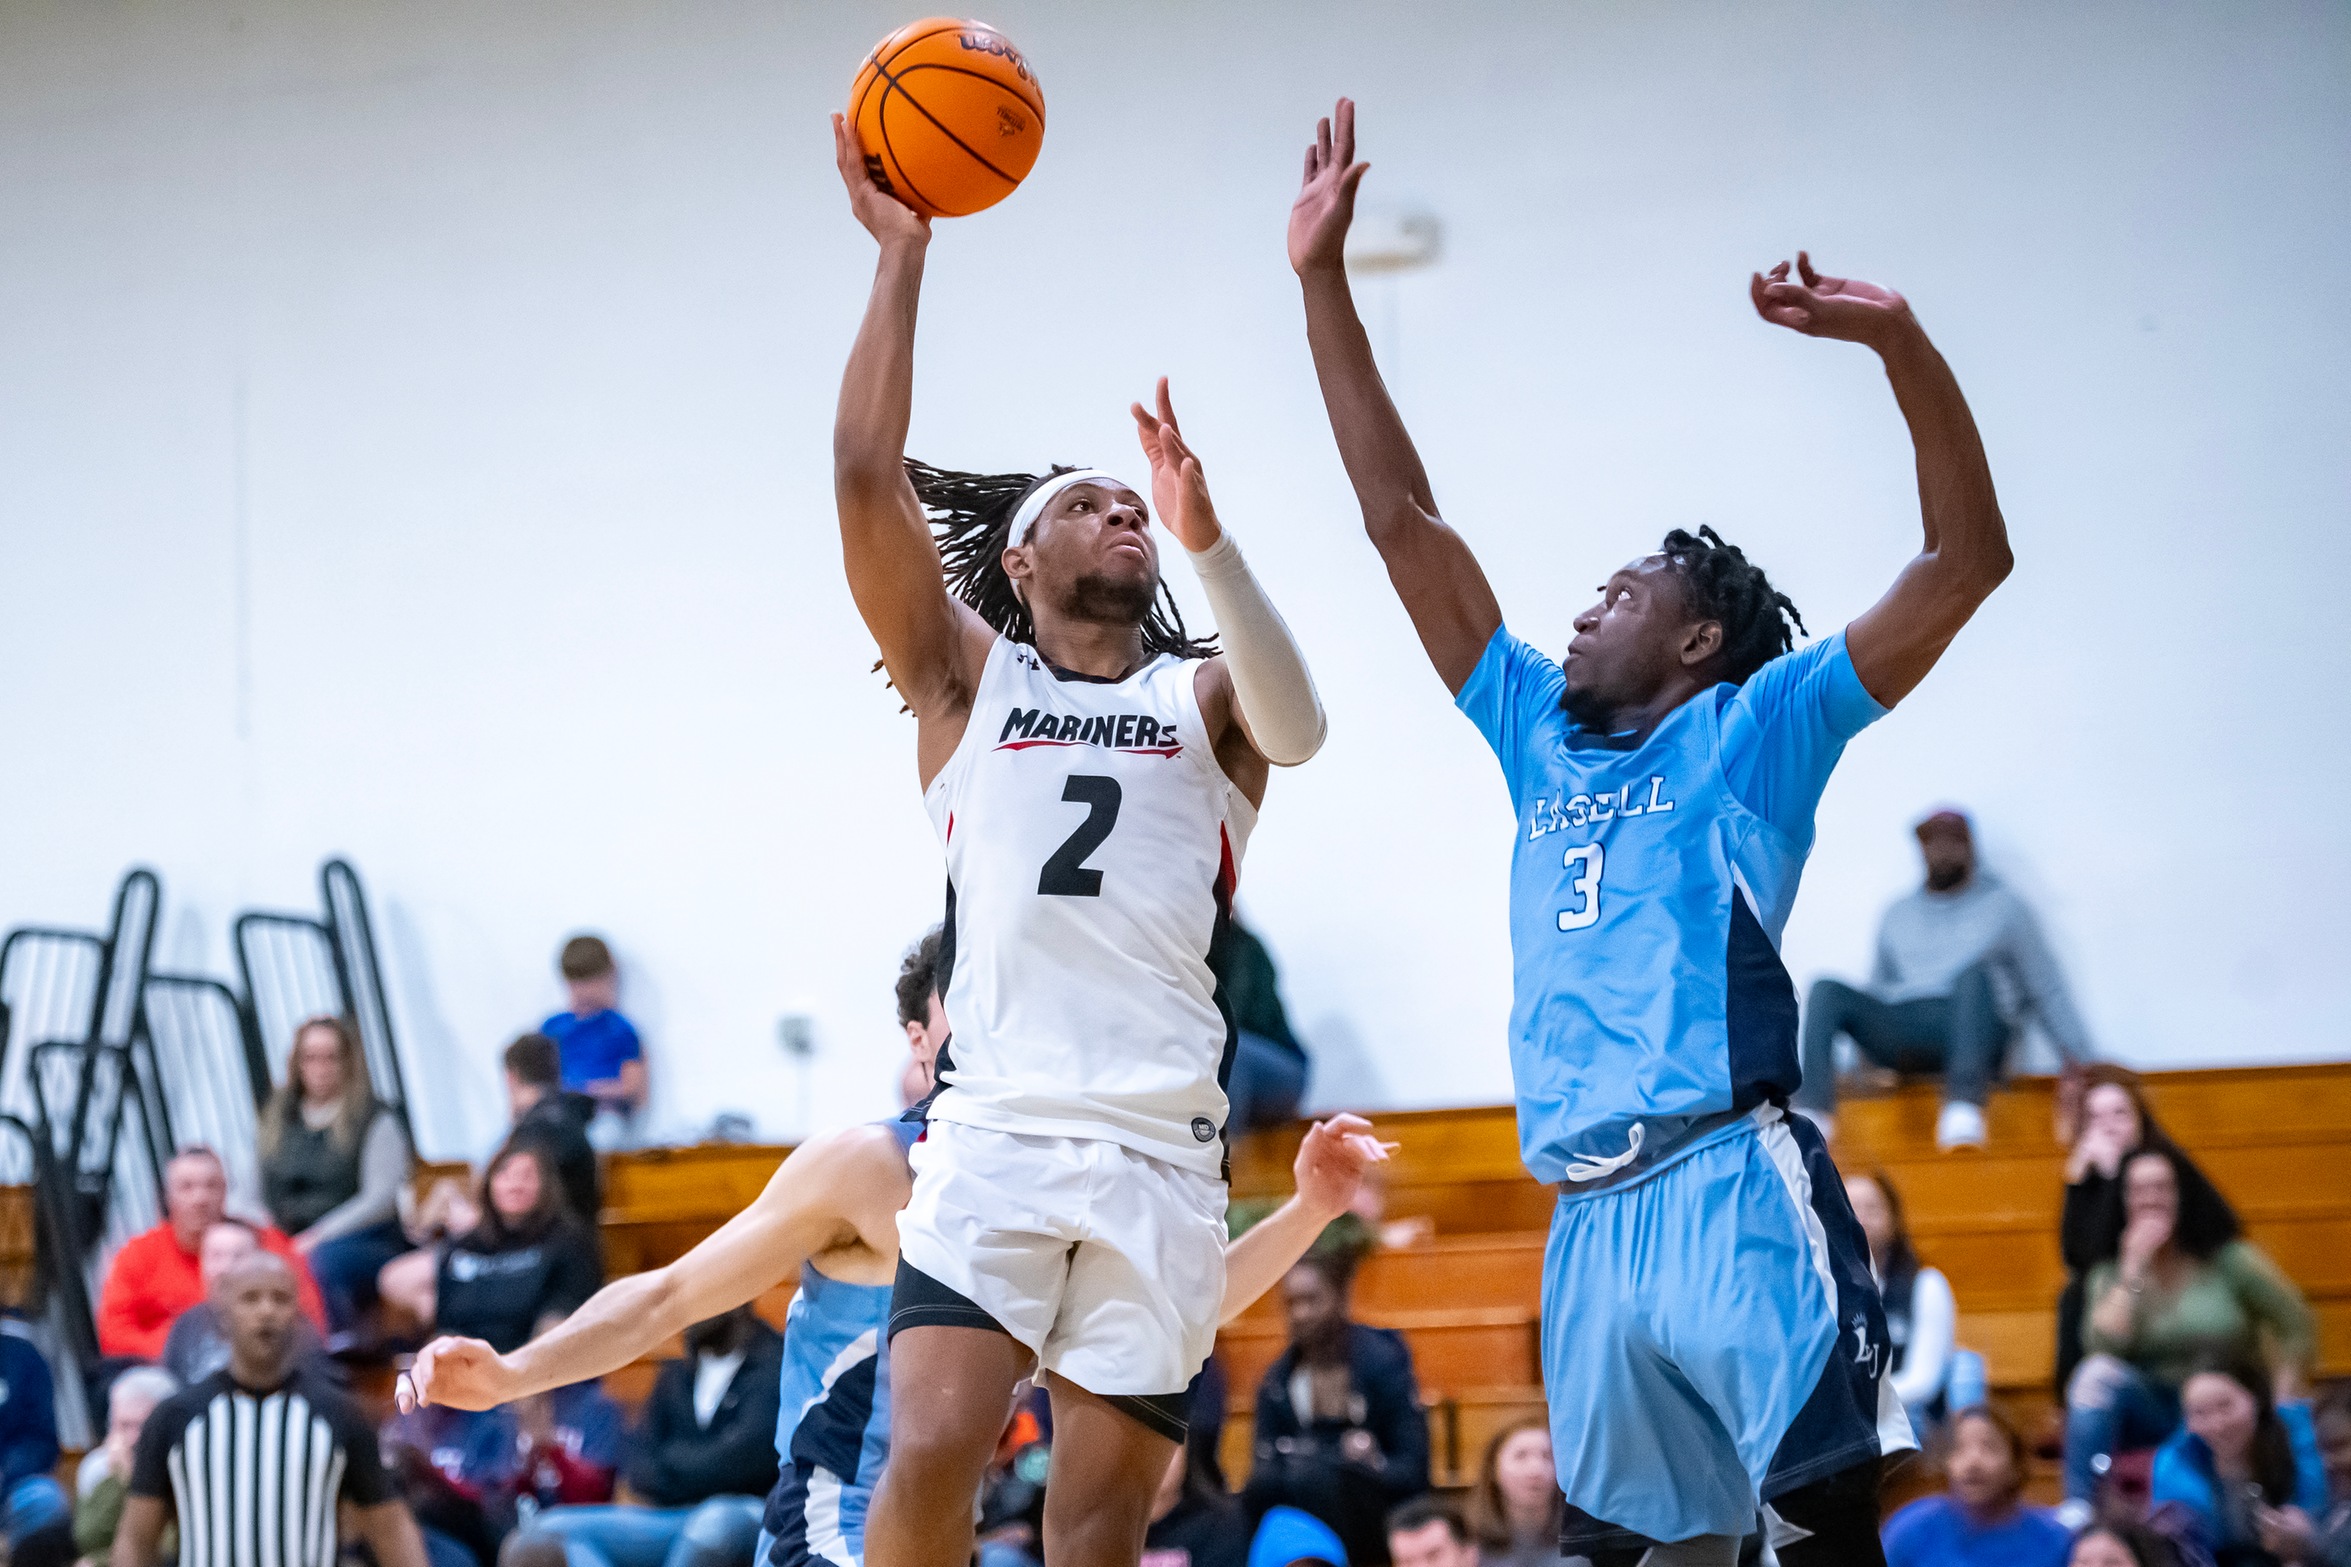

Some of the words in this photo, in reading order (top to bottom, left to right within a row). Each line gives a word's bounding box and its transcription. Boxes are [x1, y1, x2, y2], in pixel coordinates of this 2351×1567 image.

[998, 707, 1180, 748] MARINERS
[1037, 774, 1123, 897] 2
[1528, 774, 1675, 842] LASELL
[1556, 841, 1606, 932] 3
